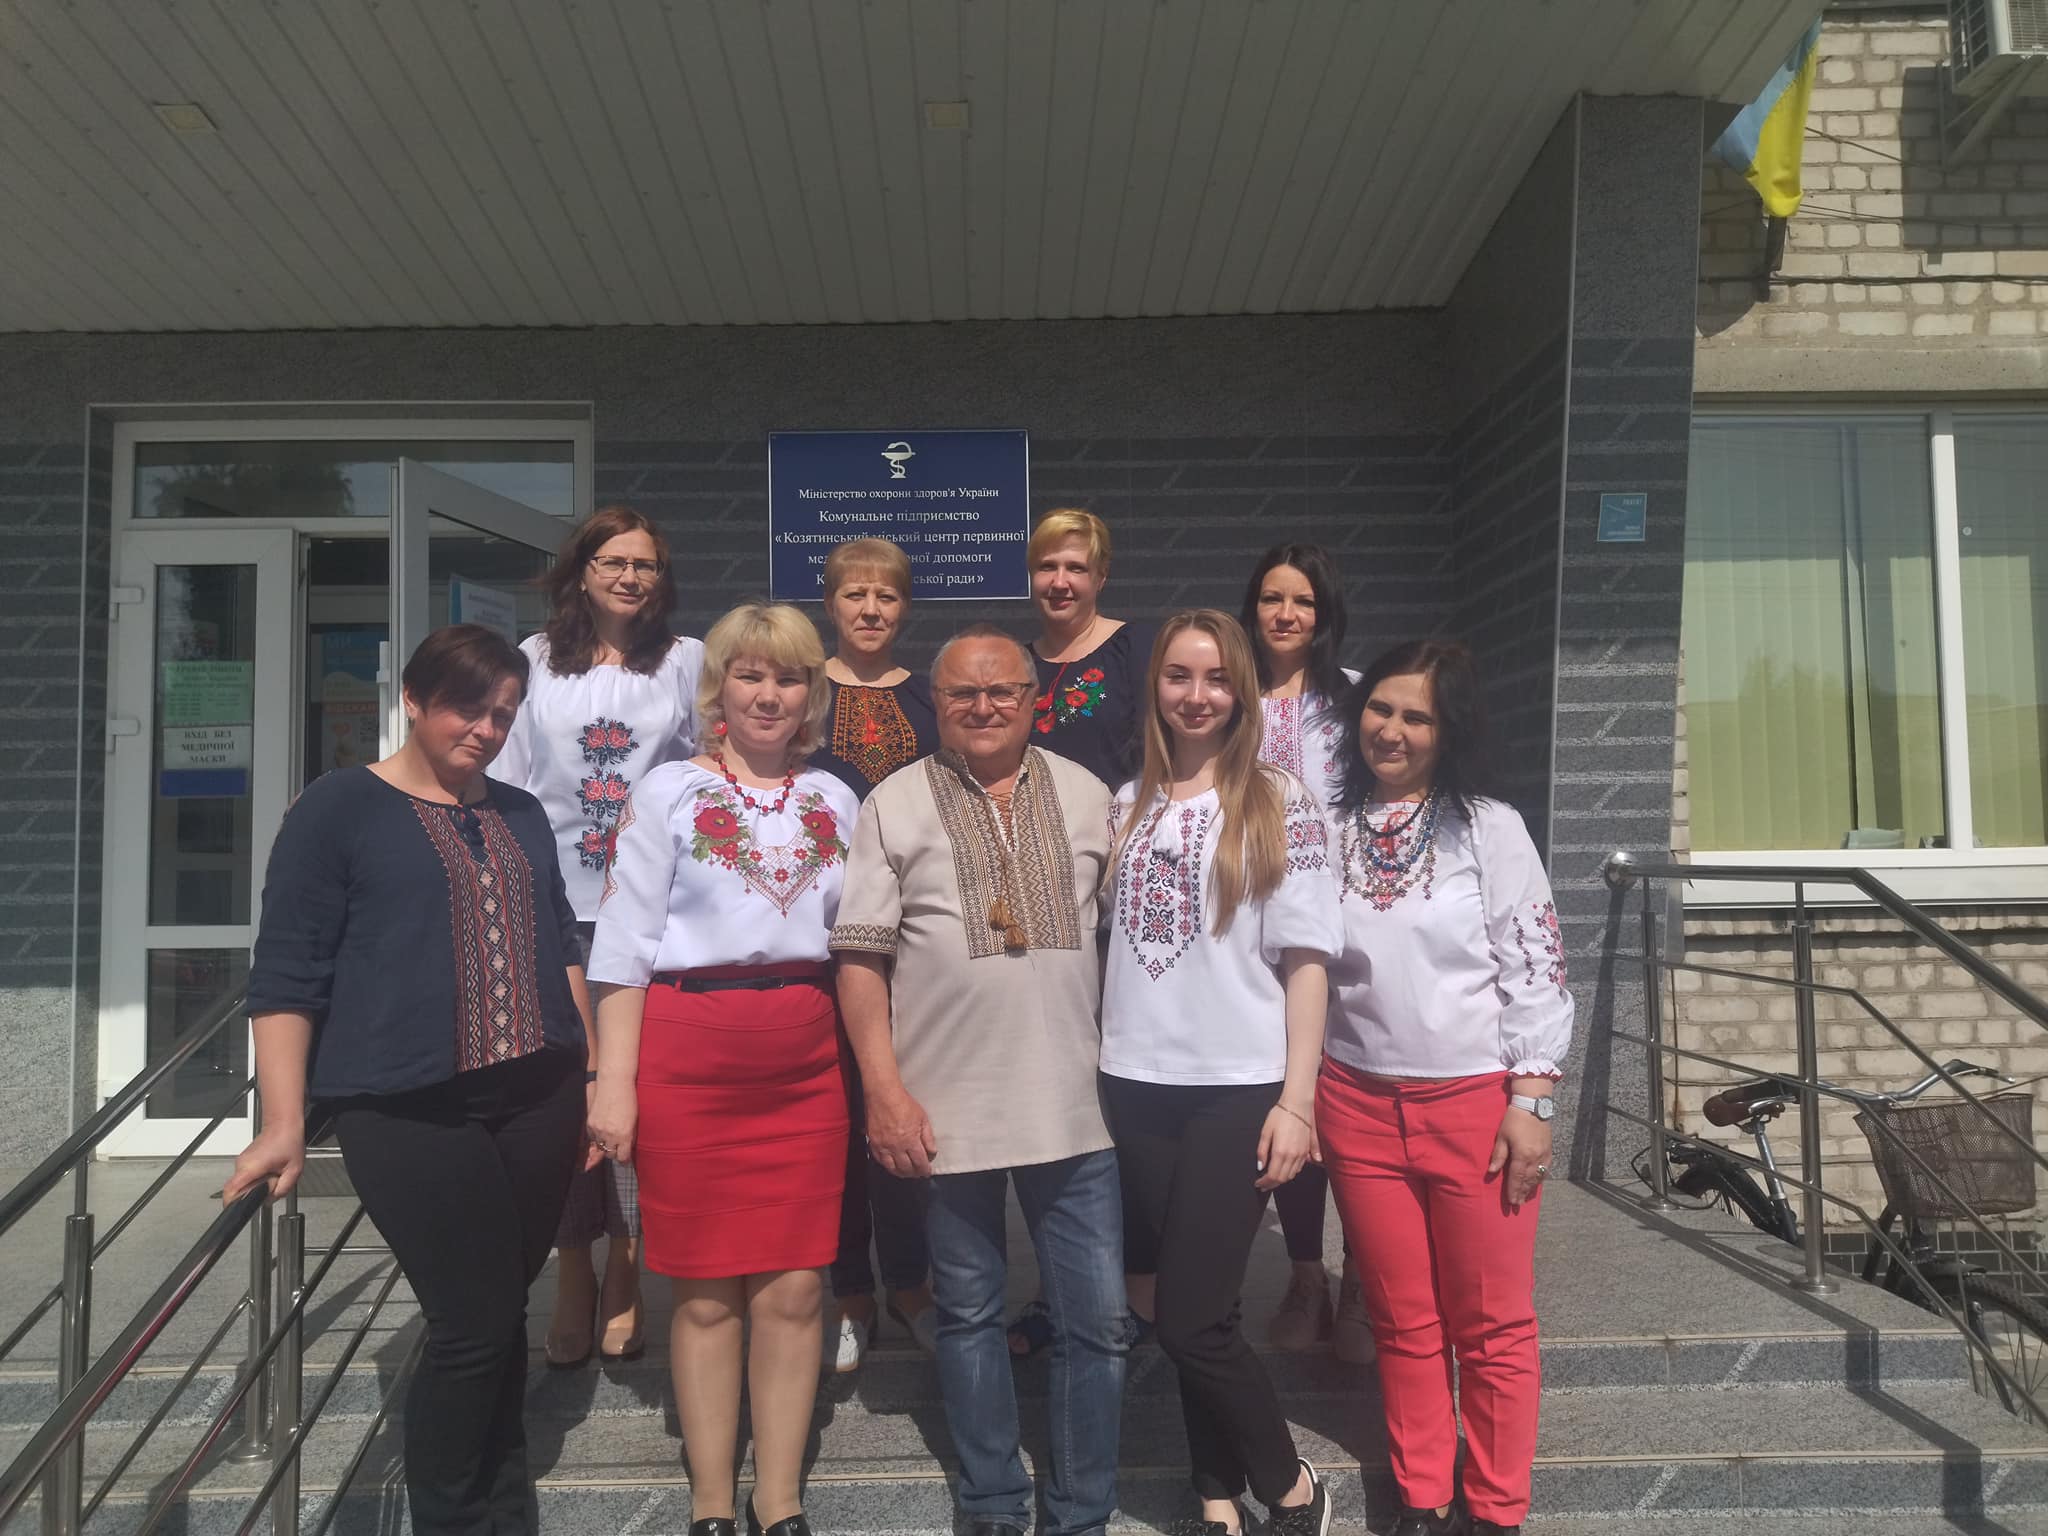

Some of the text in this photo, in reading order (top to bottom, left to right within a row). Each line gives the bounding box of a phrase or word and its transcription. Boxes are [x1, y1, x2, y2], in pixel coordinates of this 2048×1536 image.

[799, 488, 999, 500] Міністерство охорони здоров'я України
[819, 510, 979, 524] Комунальне підприємство
[874, 531, 920, 543] іський
[924, 533, 959, 545] центр
[963, 530, 1024, 544] первинної
[933, 554, 991, 564] допомоги
[913, 573, 984, 586] ської ради»
